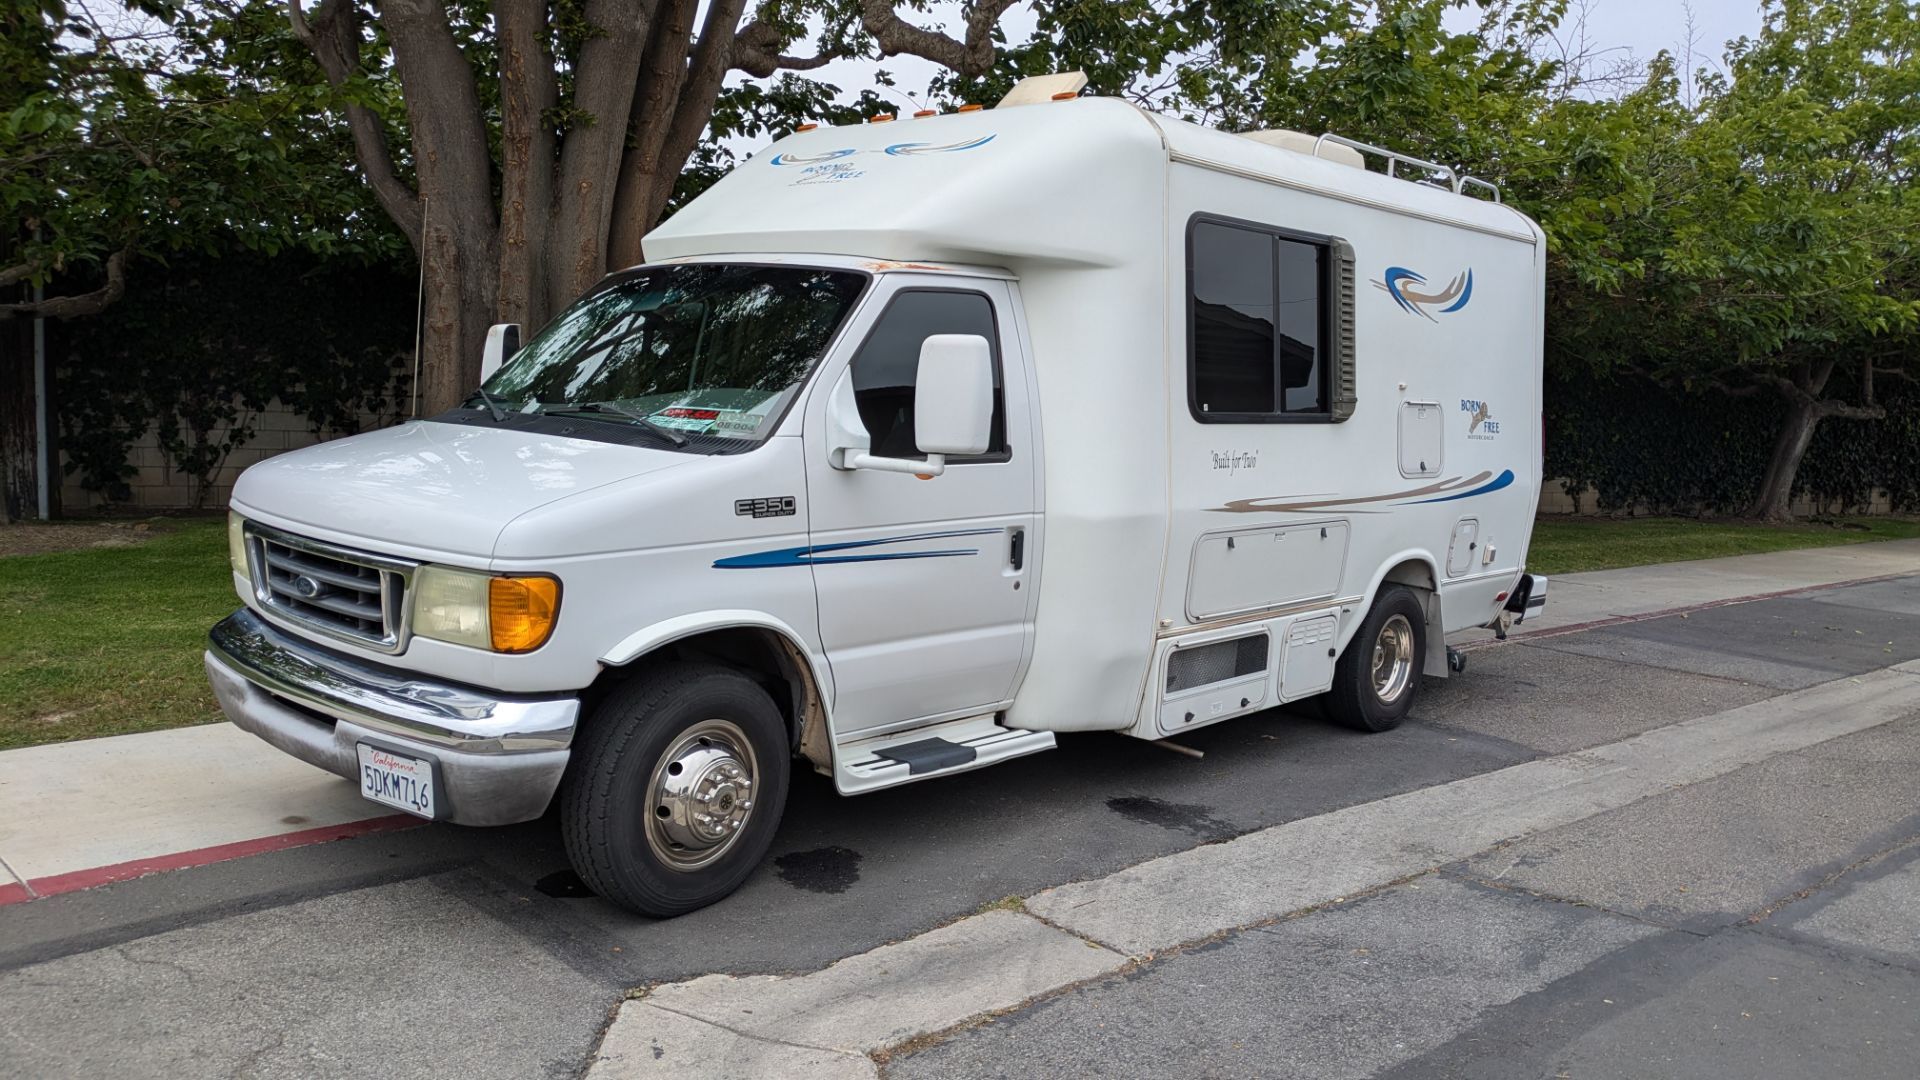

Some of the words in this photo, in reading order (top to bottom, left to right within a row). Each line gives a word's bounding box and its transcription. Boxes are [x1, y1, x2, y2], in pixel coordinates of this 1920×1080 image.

[1461, 399, 1481, 412] BORN
[1484, 421, 1500, 434] FREE
[373, 751, 416, 772] California
[364, 765, 429, 809] 5DKM716
